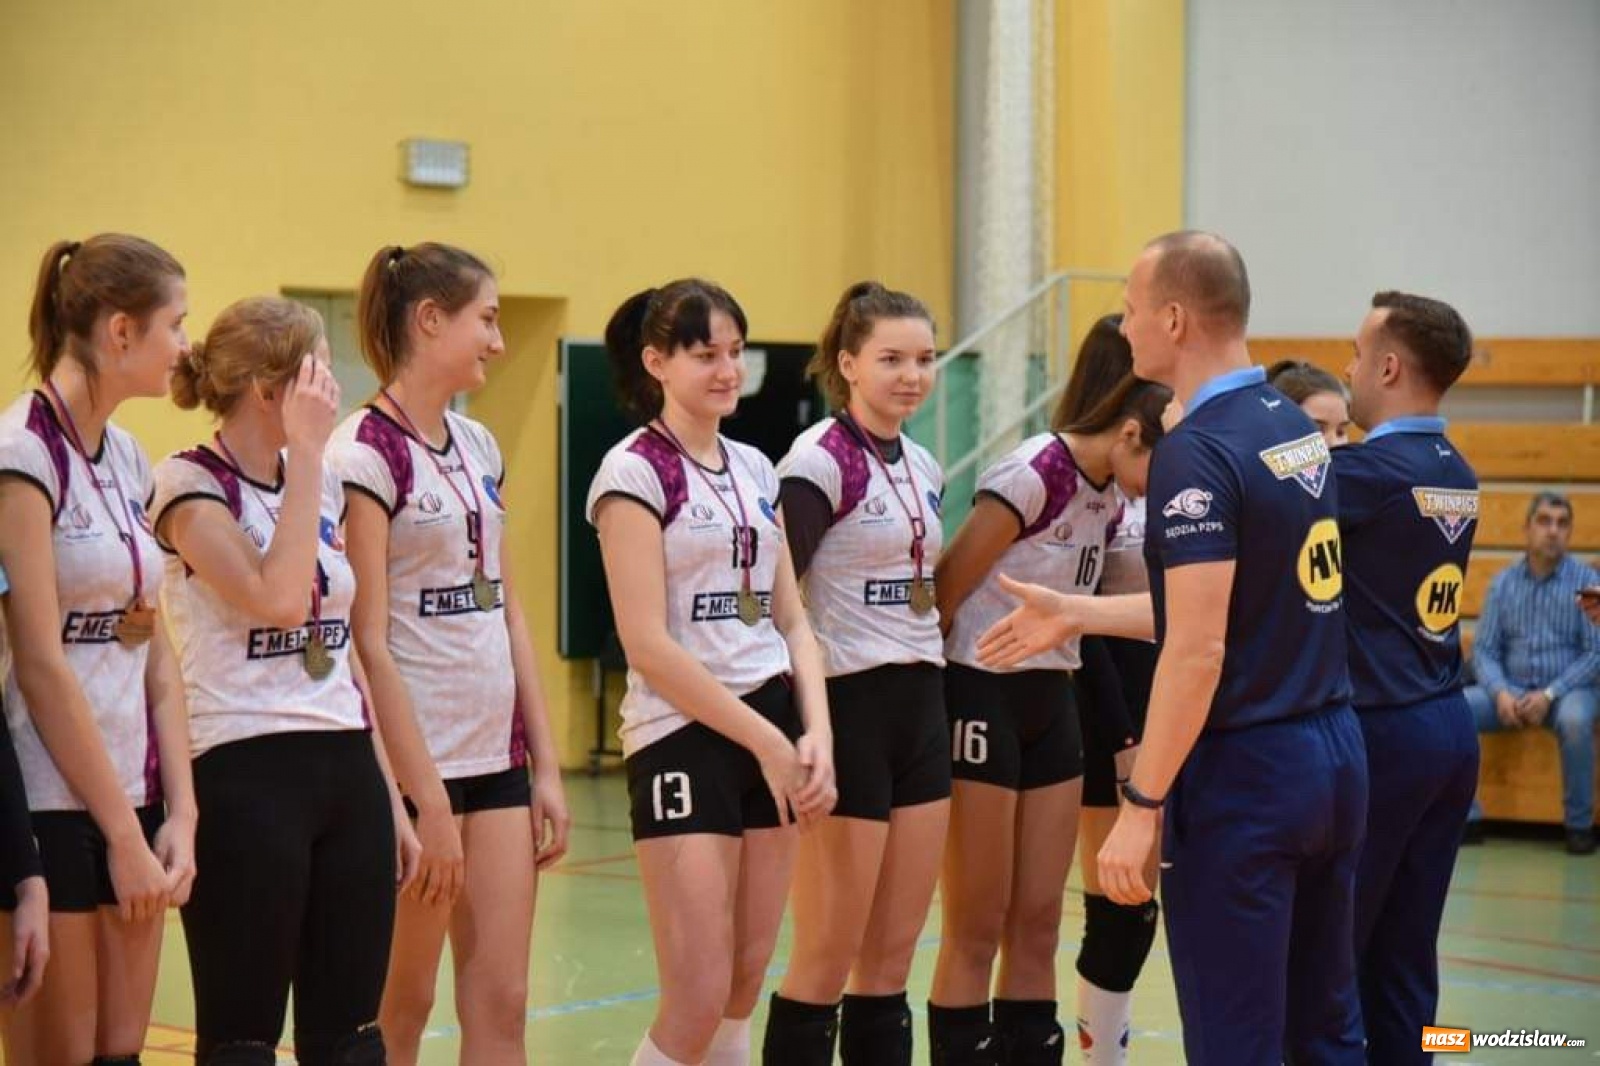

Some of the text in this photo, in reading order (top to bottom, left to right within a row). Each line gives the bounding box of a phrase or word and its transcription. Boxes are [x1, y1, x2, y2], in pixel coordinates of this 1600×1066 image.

[732, 525, 758, 569] 13
[1075, 546, 1099, 587] 16
[1309, 538, 1341, 584] HK
[1428, 582, 1459, 614] HK
[953, 719, 987, 764] 16
[652, 771, 693, 822] 13
